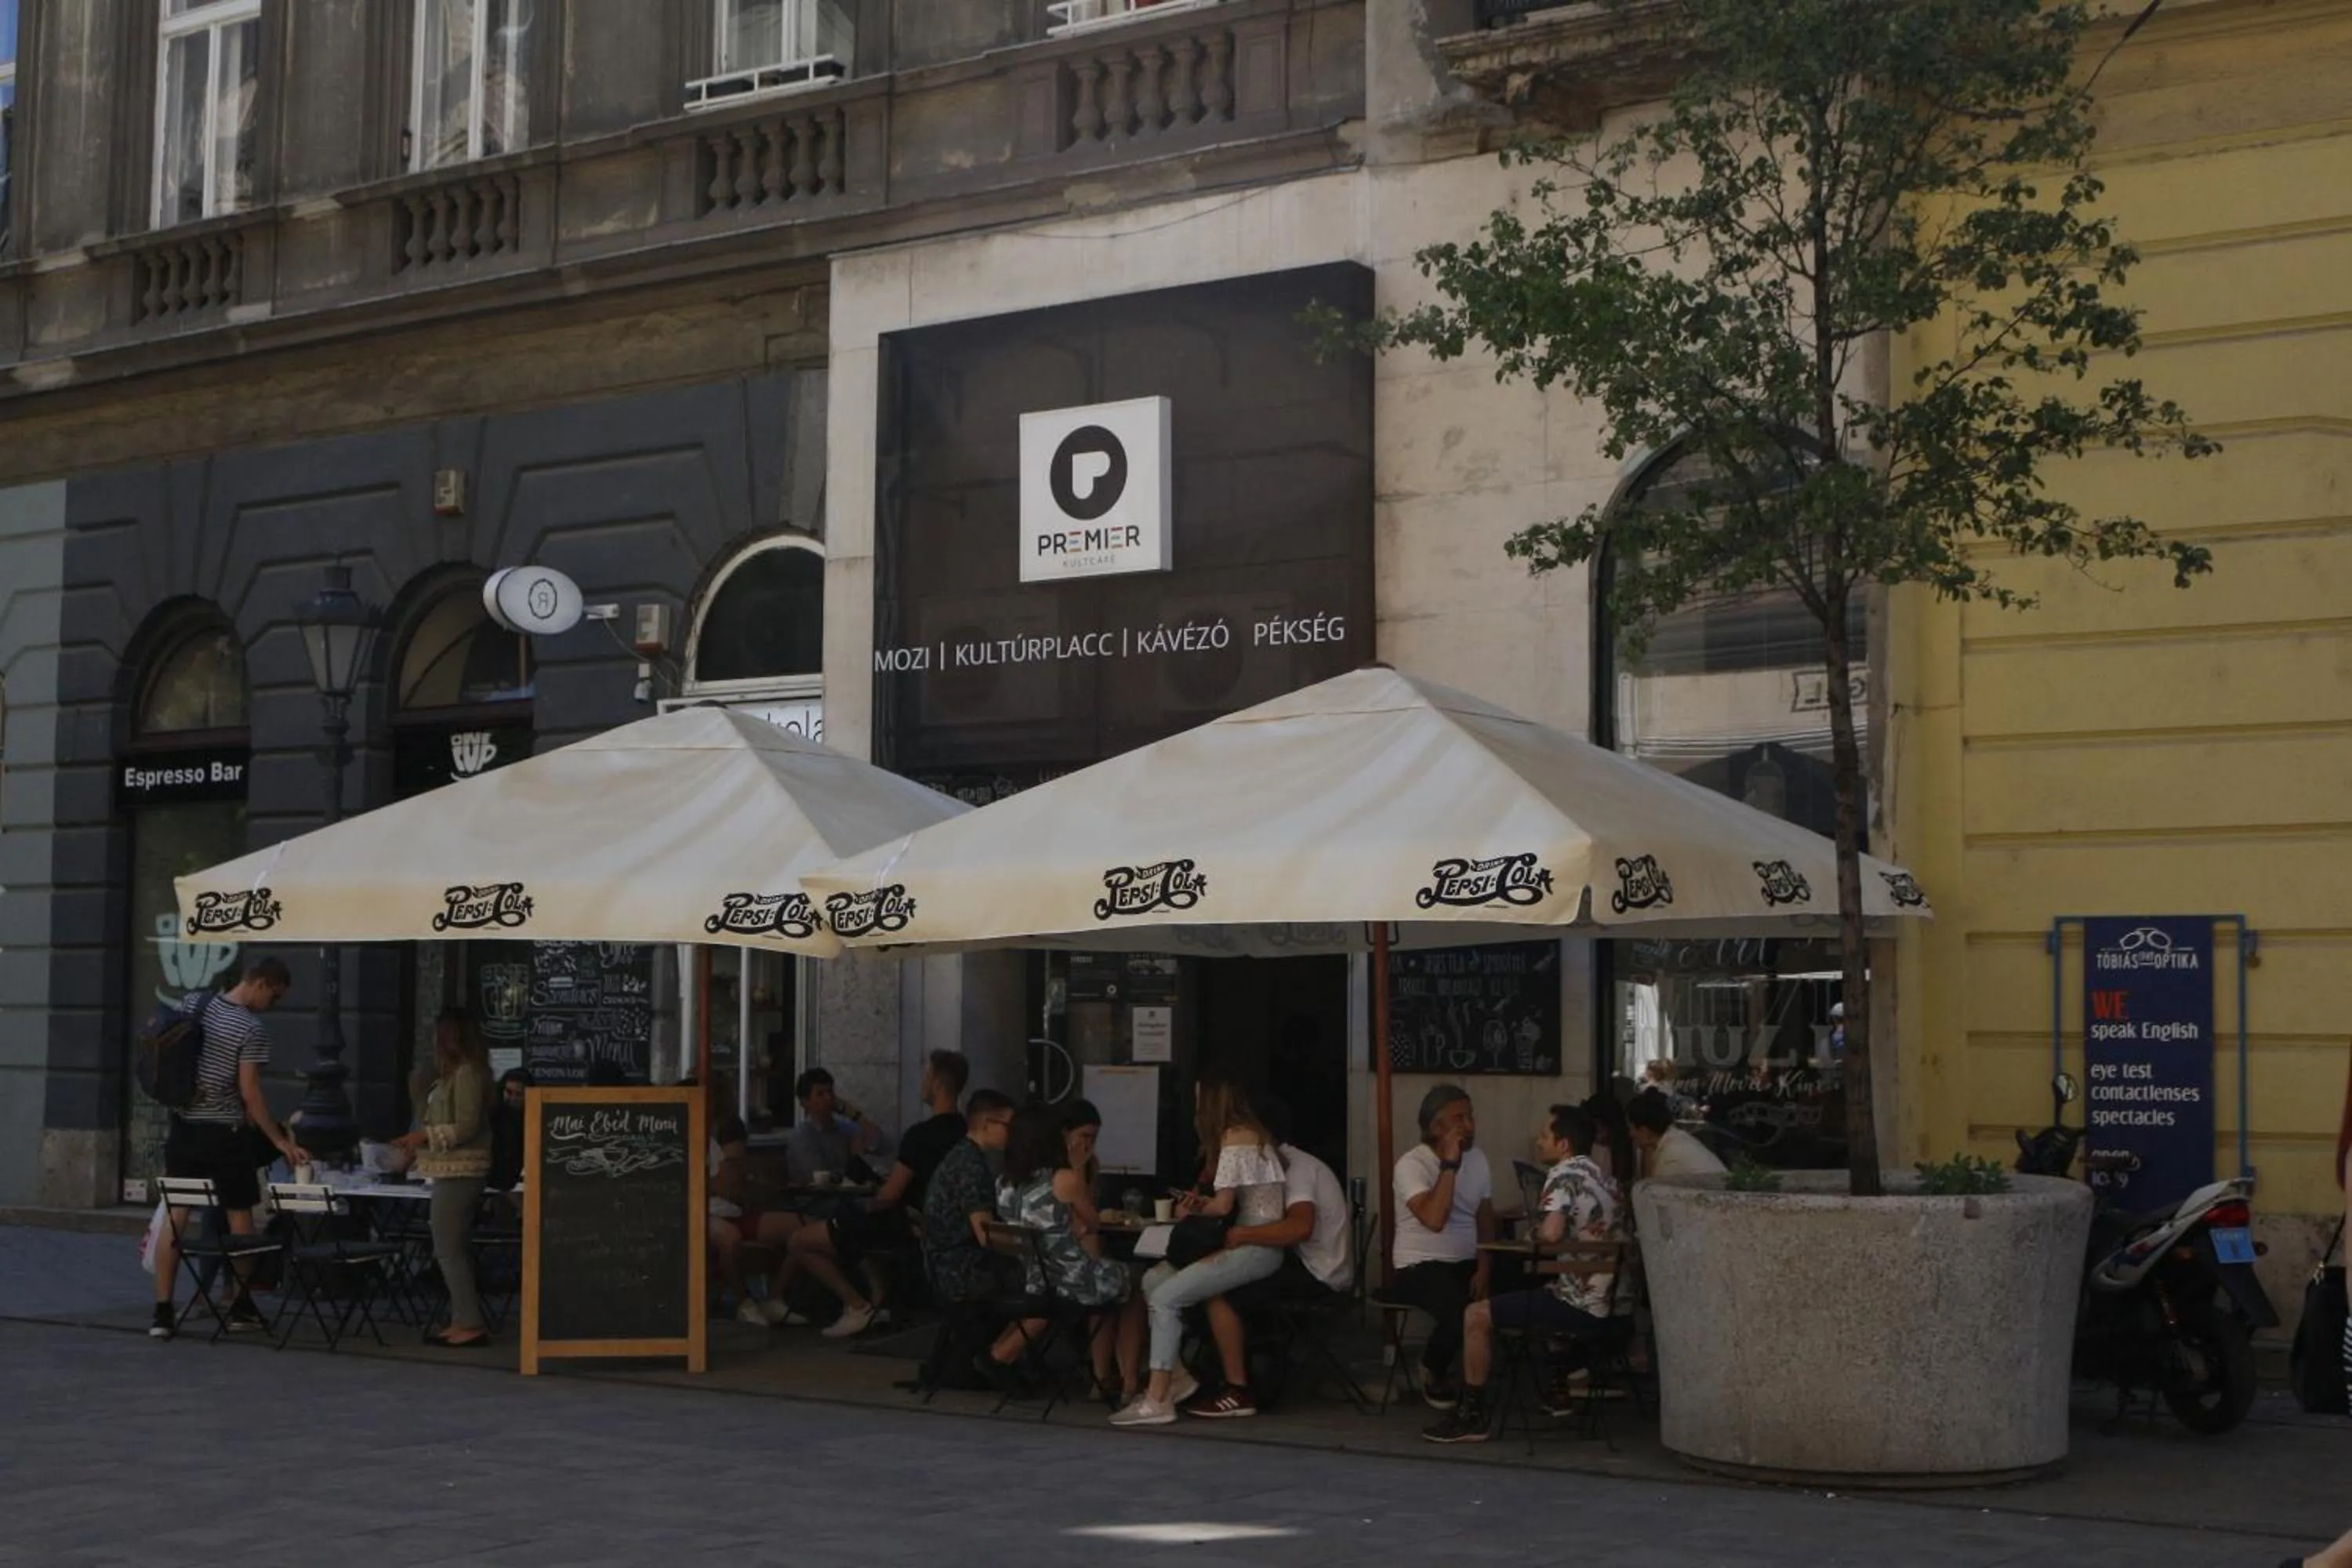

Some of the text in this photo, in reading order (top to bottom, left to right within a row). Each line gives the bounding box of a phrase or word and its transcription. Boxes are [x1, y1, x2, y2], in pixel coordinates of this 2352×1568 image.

[1037, 524, 1141, 556] PREMIER
[874, 610, 1345, 672] MOZI KULTÚRPLACC KÁVÉZÓ PÉKSÉG
[124, 760, 244, 791] Espresso Bar
[2154, 952, 2200, 970] OPTIKA
[2091, 989, 2130, 1021] WE
[2090, 1022, 2199, 1042] speak English
[2090, 1062, 2153, 1081] eye test
[2091, 1084, 2201, 1102] contactlenses
[2091, 1109, 2176, 1127] spectacles
